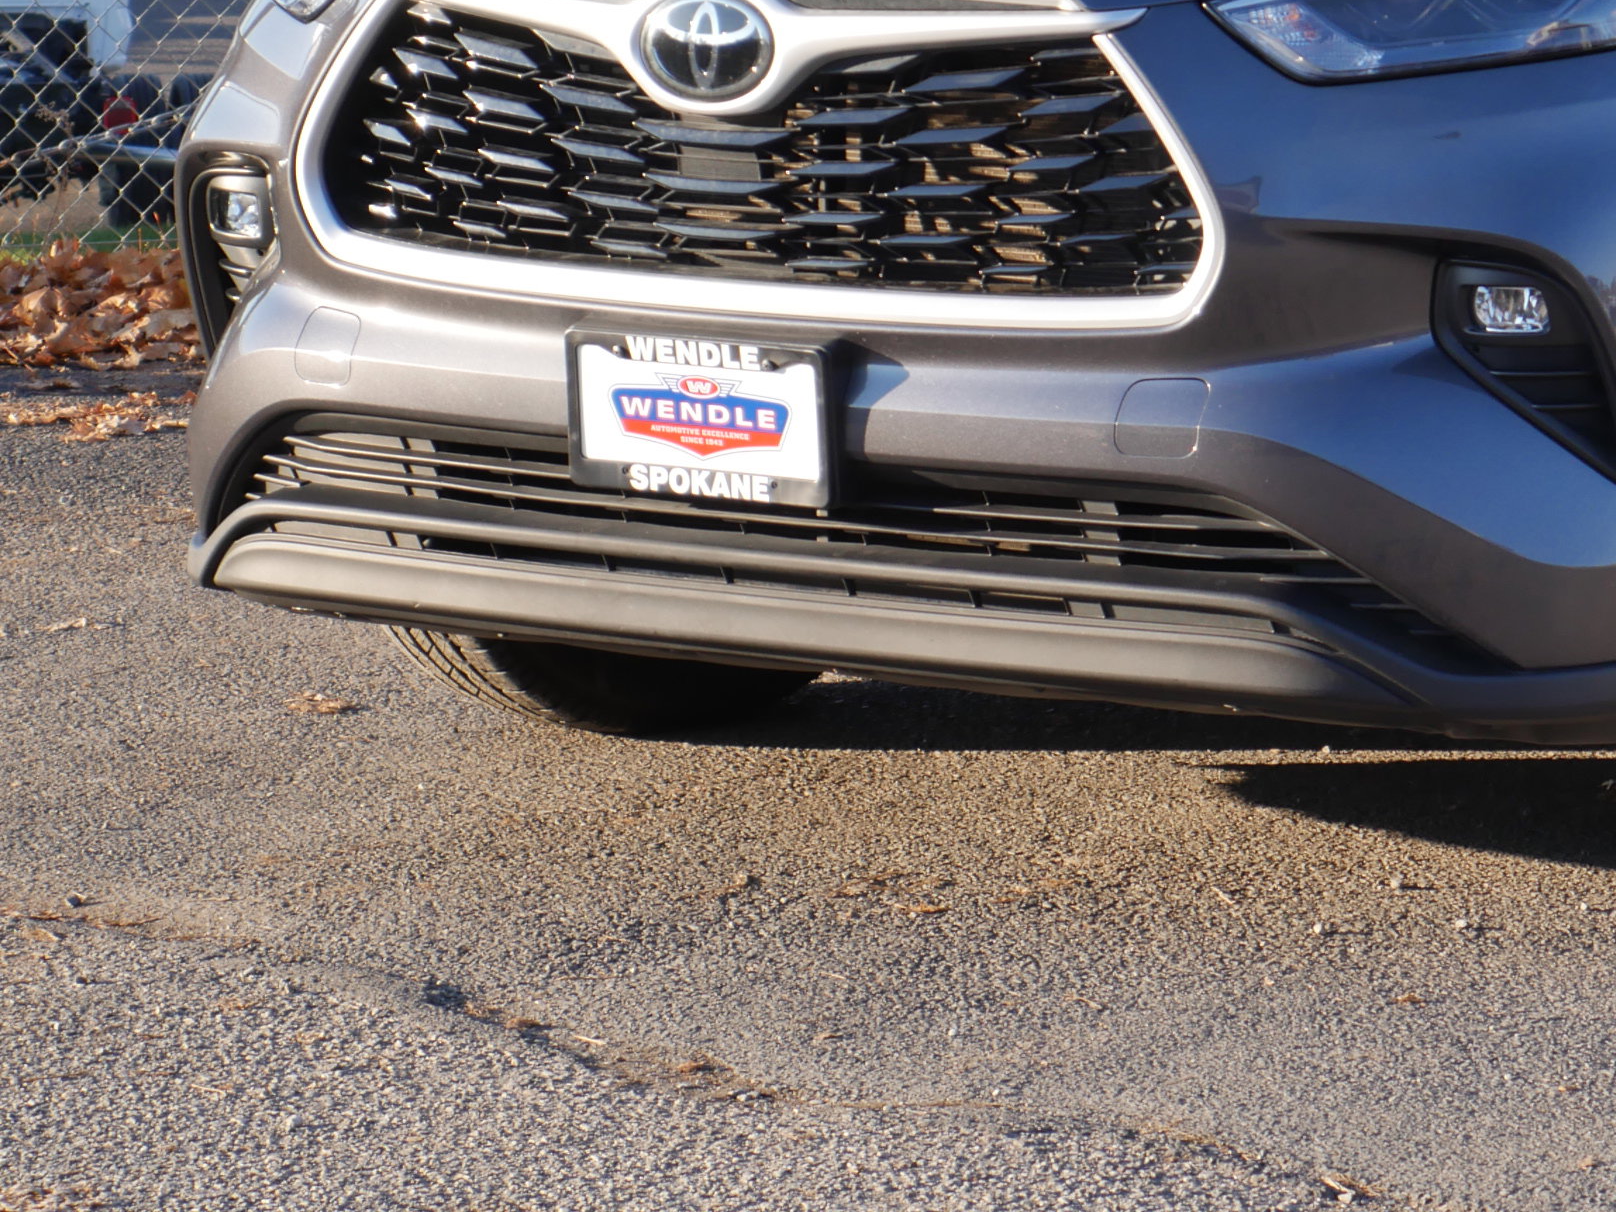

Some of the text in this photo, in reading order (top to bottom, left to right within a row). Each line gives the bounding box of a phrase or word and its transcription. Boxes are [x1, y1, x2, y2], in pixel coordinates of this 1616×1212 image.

[625, 335, 761, 371] WENDLE
[620, 395, 776, 429] WENDLE
[650, 424, 749, 440] AUTOMOTIVE EXCELLENCE
[680, 436, 705, 445] SINCE
[629, 464, 770, 502] SPOKANE
